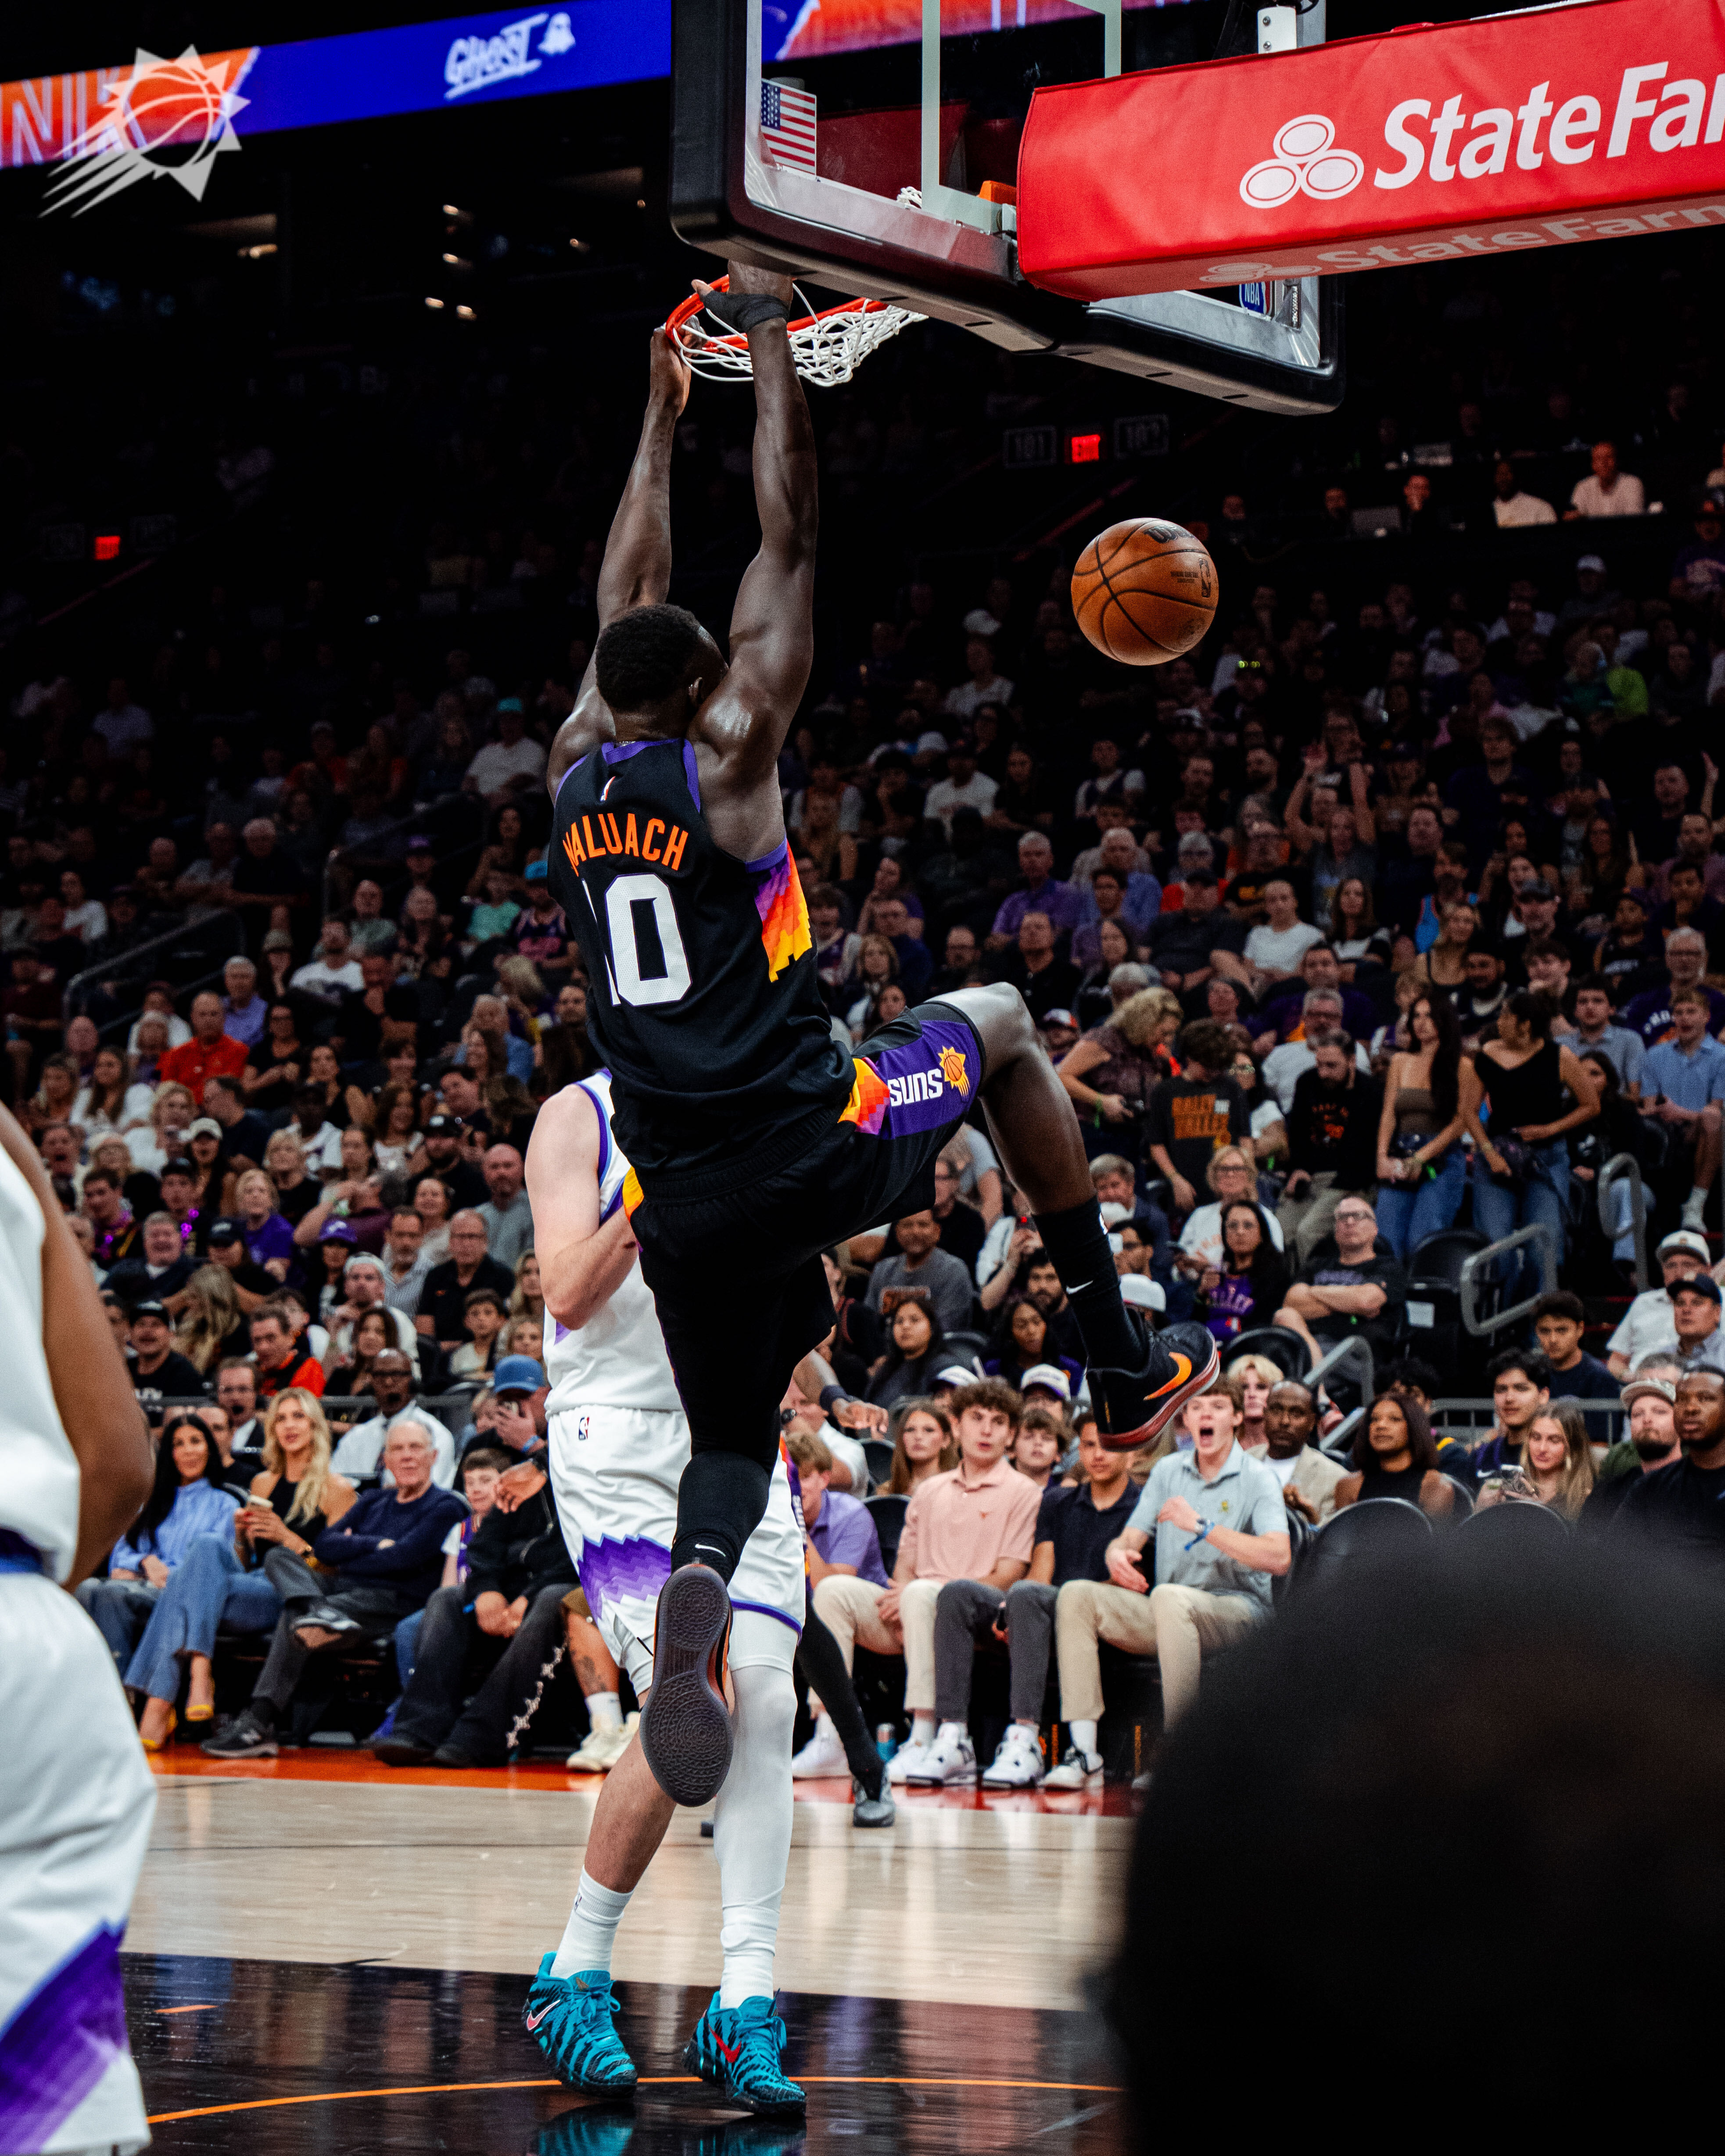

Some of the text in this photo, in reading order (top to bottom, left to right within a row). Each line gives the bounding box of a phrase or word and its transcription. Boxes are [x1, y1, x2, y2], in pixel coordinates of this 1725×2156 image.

[1244, 282, 1261, 306] NBA
[582, 873, 693, 1006] 0
[887, 1068, 943, 1107] SUNS
